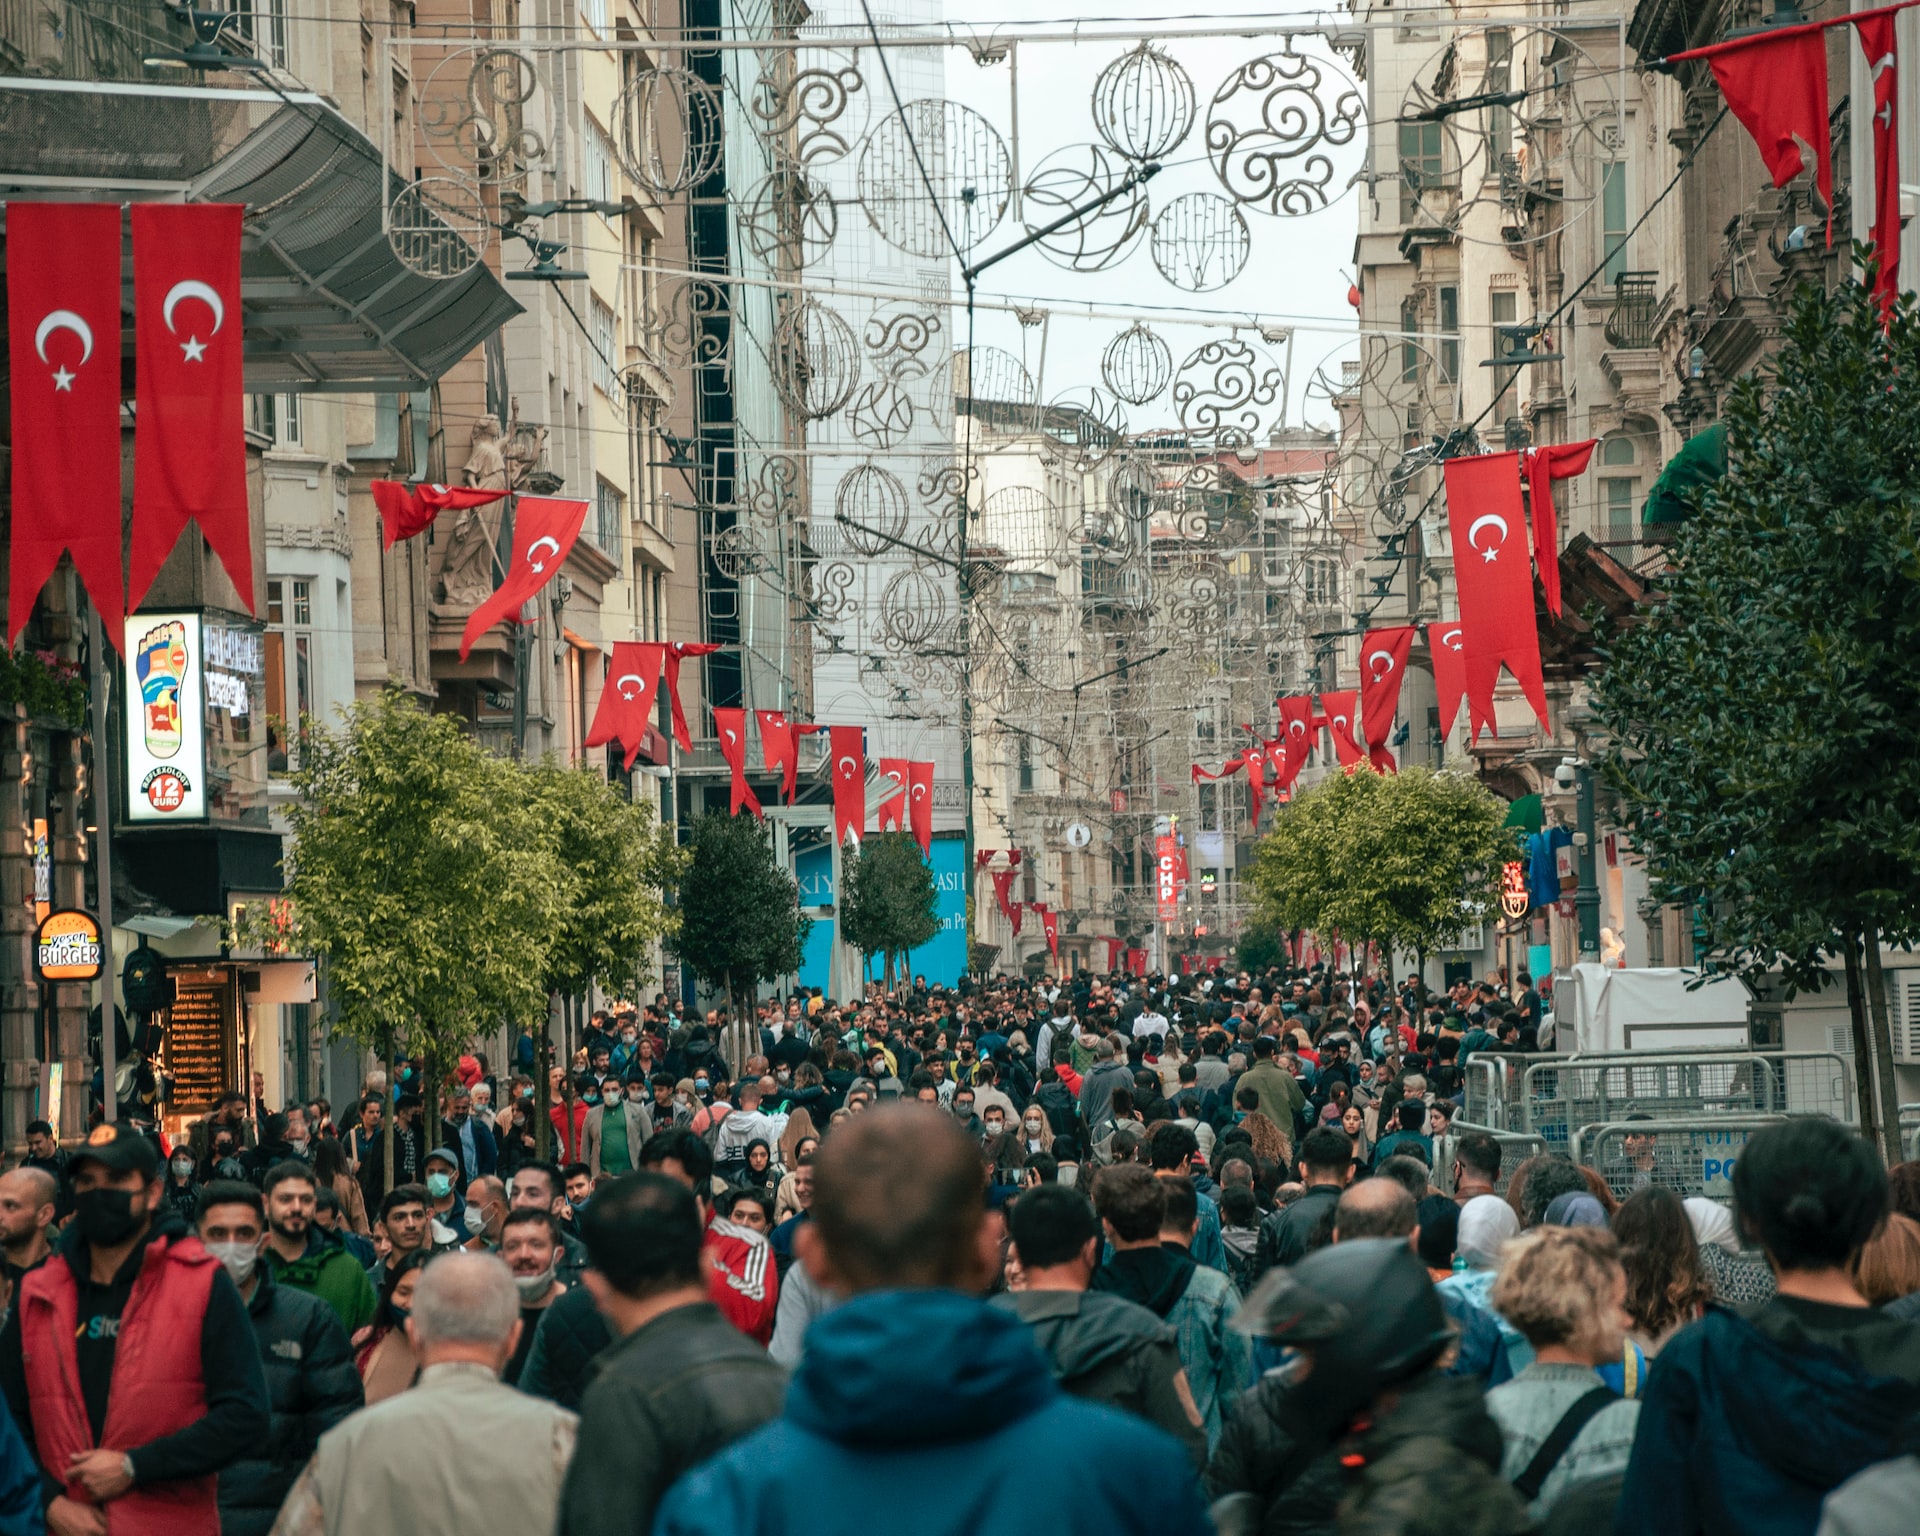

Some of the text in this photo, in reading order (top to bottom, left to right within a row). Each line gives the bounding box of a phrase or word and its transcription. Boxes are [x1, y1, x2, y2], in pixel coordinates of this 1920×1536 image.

[142, 767, 190, 789] REFLEXOLOGY
[151, 777, 179, 797] 12
[153, 797, 179, 807] EURO
[1160, 855, 1174, 900] CHP
